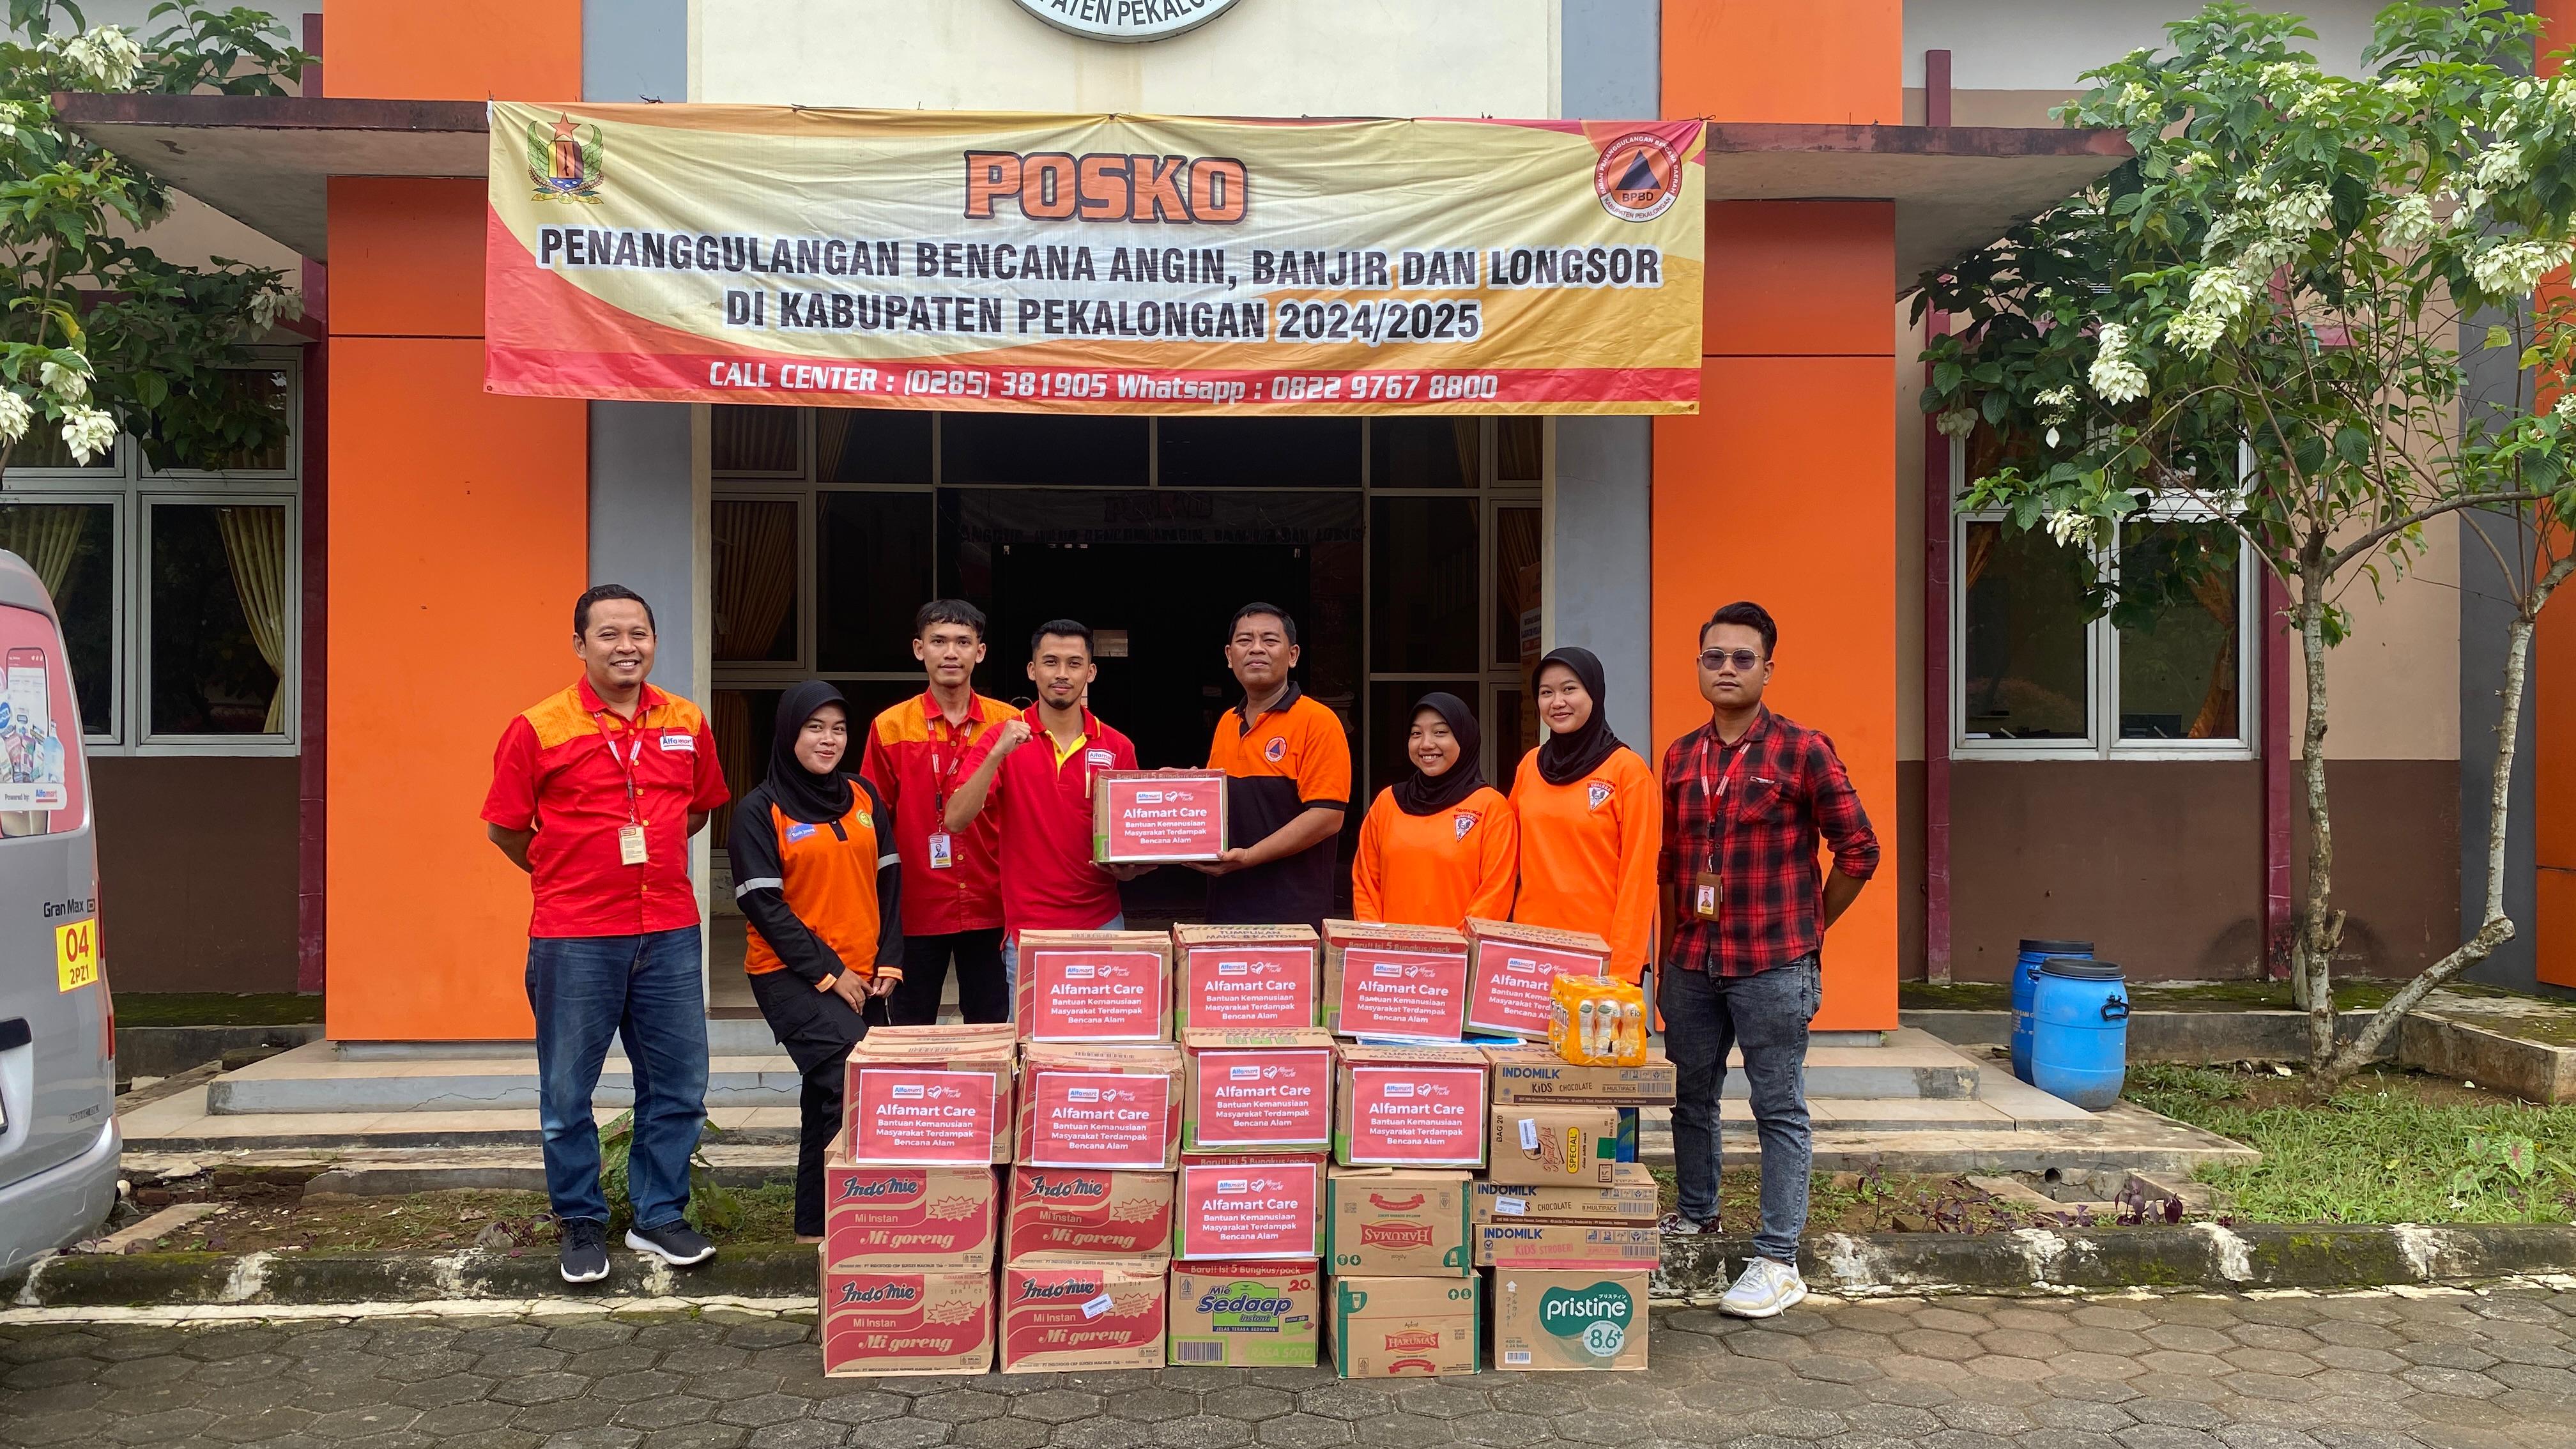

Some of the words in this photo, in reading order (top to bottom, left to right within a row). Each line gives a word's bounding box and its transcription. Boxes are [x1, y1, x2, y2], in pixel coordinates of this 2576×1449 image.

[1040, 0, 1112, 24] ATEN
[1117, 0, 1213, 26] PEKAL
[1600, 136, 1653, 171] PENANGGULANGAN
[1670, 165, 1678, 194] DAERAH
[964, 150, 1248, 224] POSKO
[1622, 192, 1653, 202] BPBD
[1604, 197, 1634, 218] KABUPATEN
[1635, 198, 1671, 218] PEKALONGAN
[541, 229, 900, 276] PENANGGULANGAN
[917, 243, 1095, 281] BENCANA
[1110, 247, 1236, 291] ANGIN,
[1254, 249, 1387, 286] BANJIR
[1404, 250, 1475, 286] DAN
[1491, 248, 1658, 286] LONGSOR
[727, 291, 762, 328] DI
[781, 293, 1001, 332] KABUPATEN
[1019, 298, 1264, 339] PEKALONGAN
[1279, 303, 1478, 341] 2024/2025
[710, 362, 770, 388] CALL
[781, 364, 876, 392] CENTER
[905, 369, 990, 398] (0285)
[1001, 372, 1107, 398] 381905
[1117, 375, 1245, 403] Whatsapp
[1272, 376, 1340, 399] 0822
[1349, 376, 1421, 399] 9767
[1429, 375, 1498, 398] 8800
[36, 788, 57, 797] Alfamart
[1123, 808, 1176, 818] Alfamart
[1180, 808, 1207, 817] Care
[44, 902, 65, 917] Gran
[68, 899, 84, 914] Max
[66, 925, 89, 962] 04
[70, 965, 89, 985] 2PZ1
[1204, 981, 1263, 991] Alfamart
[1266, 981, 1296, 990] Care
[1491, 974, 1549, 990] Alfamart
[1050, 985, 1110, 995] Alfamart
[1114, 985, 1144, 994] Care
[1358, 981, 1416, 993] Alfamart
[1419, 985, 1448, 996] Care
[1492, 988, 1523, 997] Bantuan
[1393, 997, 1445, 1006] Kemanusiaan
[1489, 997, 1532, 1009] Masyarakat
[1357, 1004, 1400, 1013] Masyarakat
[1402, 1007, 1446, 1015] Terdampak
[1504, 1008, 1537, 1018] Bencana
[1503, 1067, 1560, 1079] INDOMILK
[1215, 1087, 1276, 1098] Alfamart
[1280, 1086, 1311, 1096] Care
[1560, 1082, 1592, 1092] CHOCOLATE
[876, 1105, 940, 1116] Alfamart
[944, 1107, 976, 1116] Care
[1052, 1108, 1114, 1119] Alfamart
[1118, 1109, 1149, 1119] Care
[1369, 1103, 1430, 1114] Alfamart
[1434, 1104, 1464, 1114] Care
[1496, 1116, 1503, 1125] 20
[1478, 1184, 1537, 1196] INDOMILK
[1202, 1200, 1264, 1211] Alfamart
[1267, 1199, 1298, 1209] Care
[1538, 1202, 1572, 1211] CHOCOLATE
[1039, 1211, 1050, 1220] Mi
[1052, 1212, 1082, 1223] Instan
[860, 1231, 887, 1245] Mi
[890, 1234, 956, 1248] goreng
[1043, 1228, 1071, 1241] Mi
[1072, 1233, 1137, 1248] goreng
[1365, 1229, 1429, 1241] HARUMAS
[1484, 1228, 1542, 1239] INDOMILK
[1230, 1264, 1238, 1273] 5
[1209, 1286, 1230, 1294] Mie
[1288, 1279, 1310, 1292] 20
[1197, 1294, 1292, 1316] Sedaap
[1547, 1298, 1626, 1320] pristine
[866, 1319, 896, 1327] Instan
[1033, 1314, 1045, 1322] Mi
[859, 1335, 886, 1349] Mi
[889, 1338, 954, 1353] goreng
[1039, 1330, 1067, 1342] Mi
[1068, 1330, 1132, 1346] goreng
[1389, 1336, 1436, 1347] HARUMAS
[1284, 1347, 1313, 1358] SOTO
